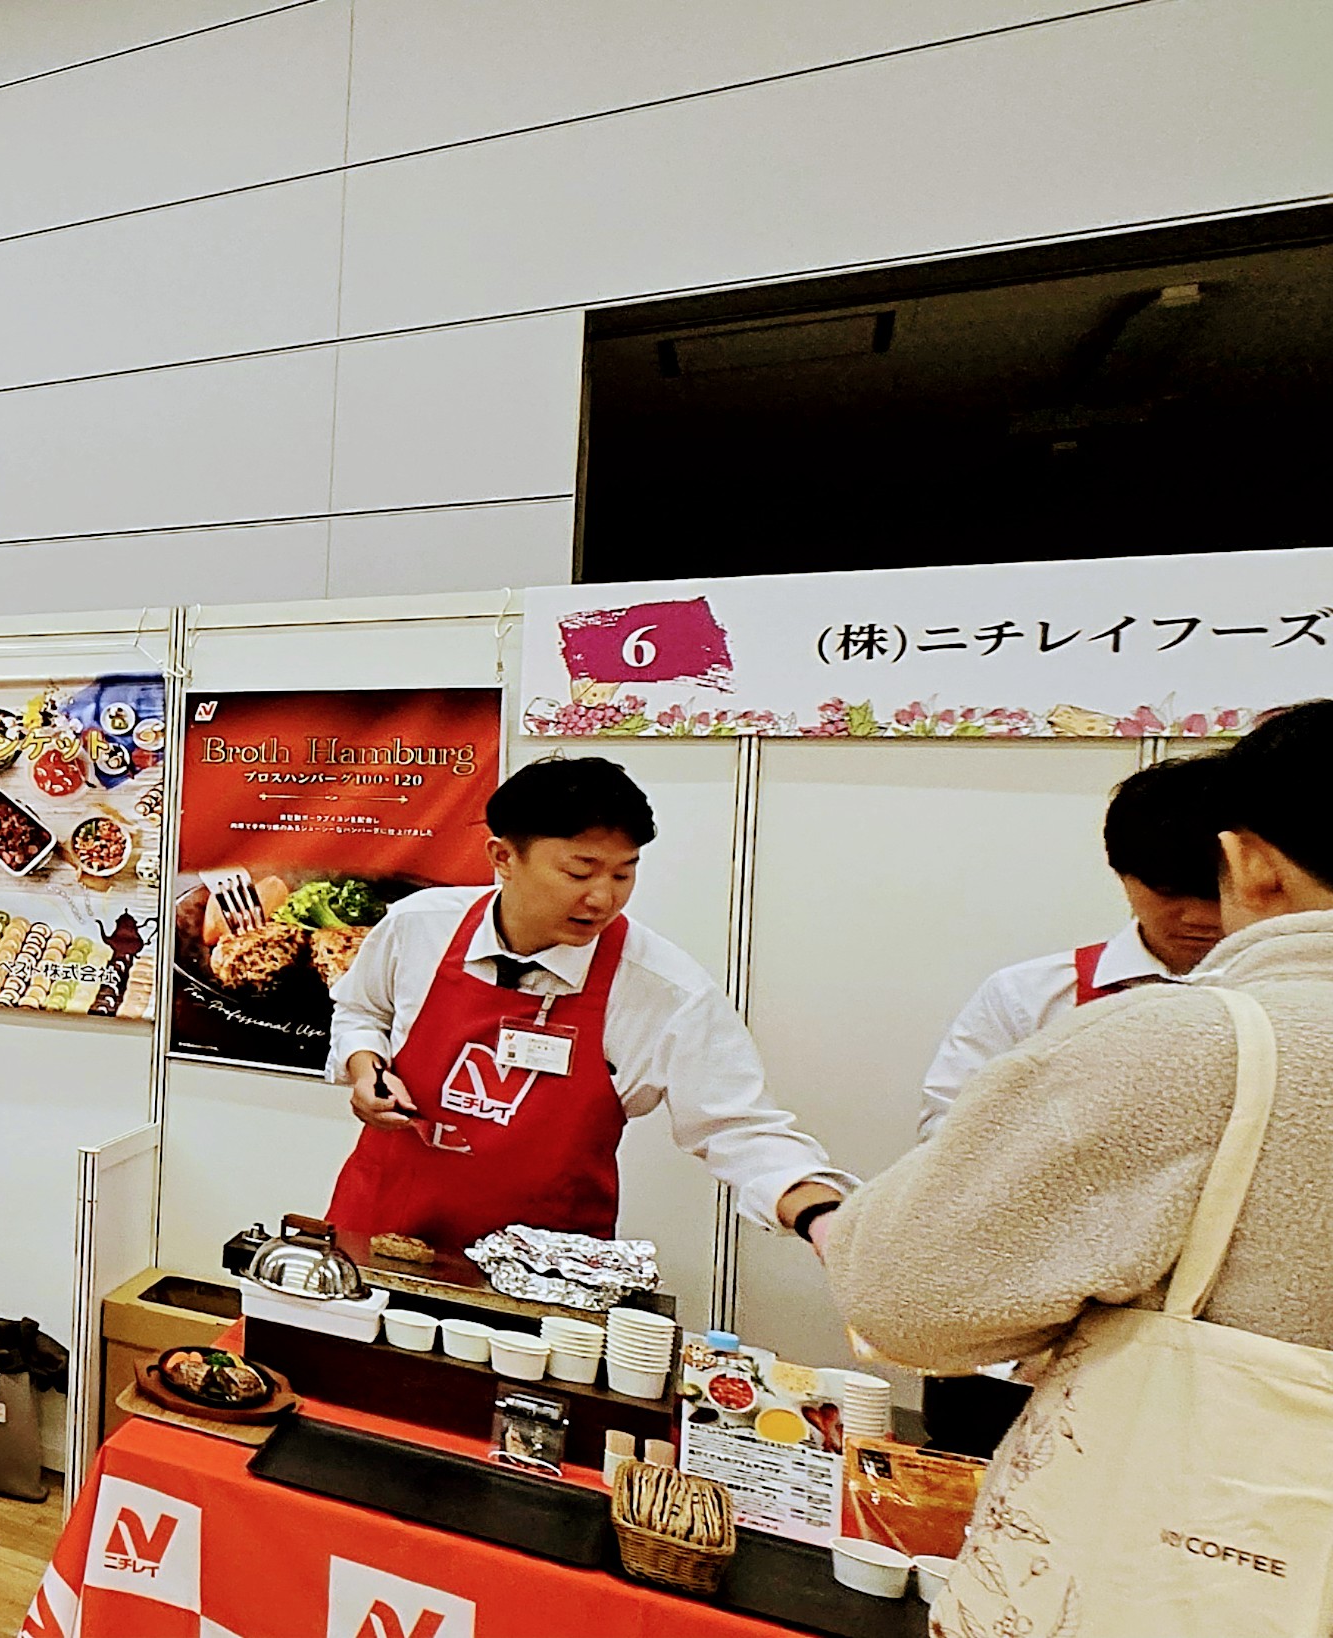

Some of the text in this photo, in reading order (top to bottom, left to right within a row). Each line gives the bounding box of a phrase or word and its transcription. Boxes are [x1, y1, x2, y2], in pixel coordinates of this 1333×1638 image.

[622, 625, 658, 667] 6
[817, 606, 1333, 665] (株)ニチレイフーズ
[201, 737, 476, 776] Broth Hamburg
[446, 1092, 512, 1119] ニチレイ
[104, 1555, 161, 1578] ニチレイ
[1185, 1537, 1287, 1579] COFFEE
